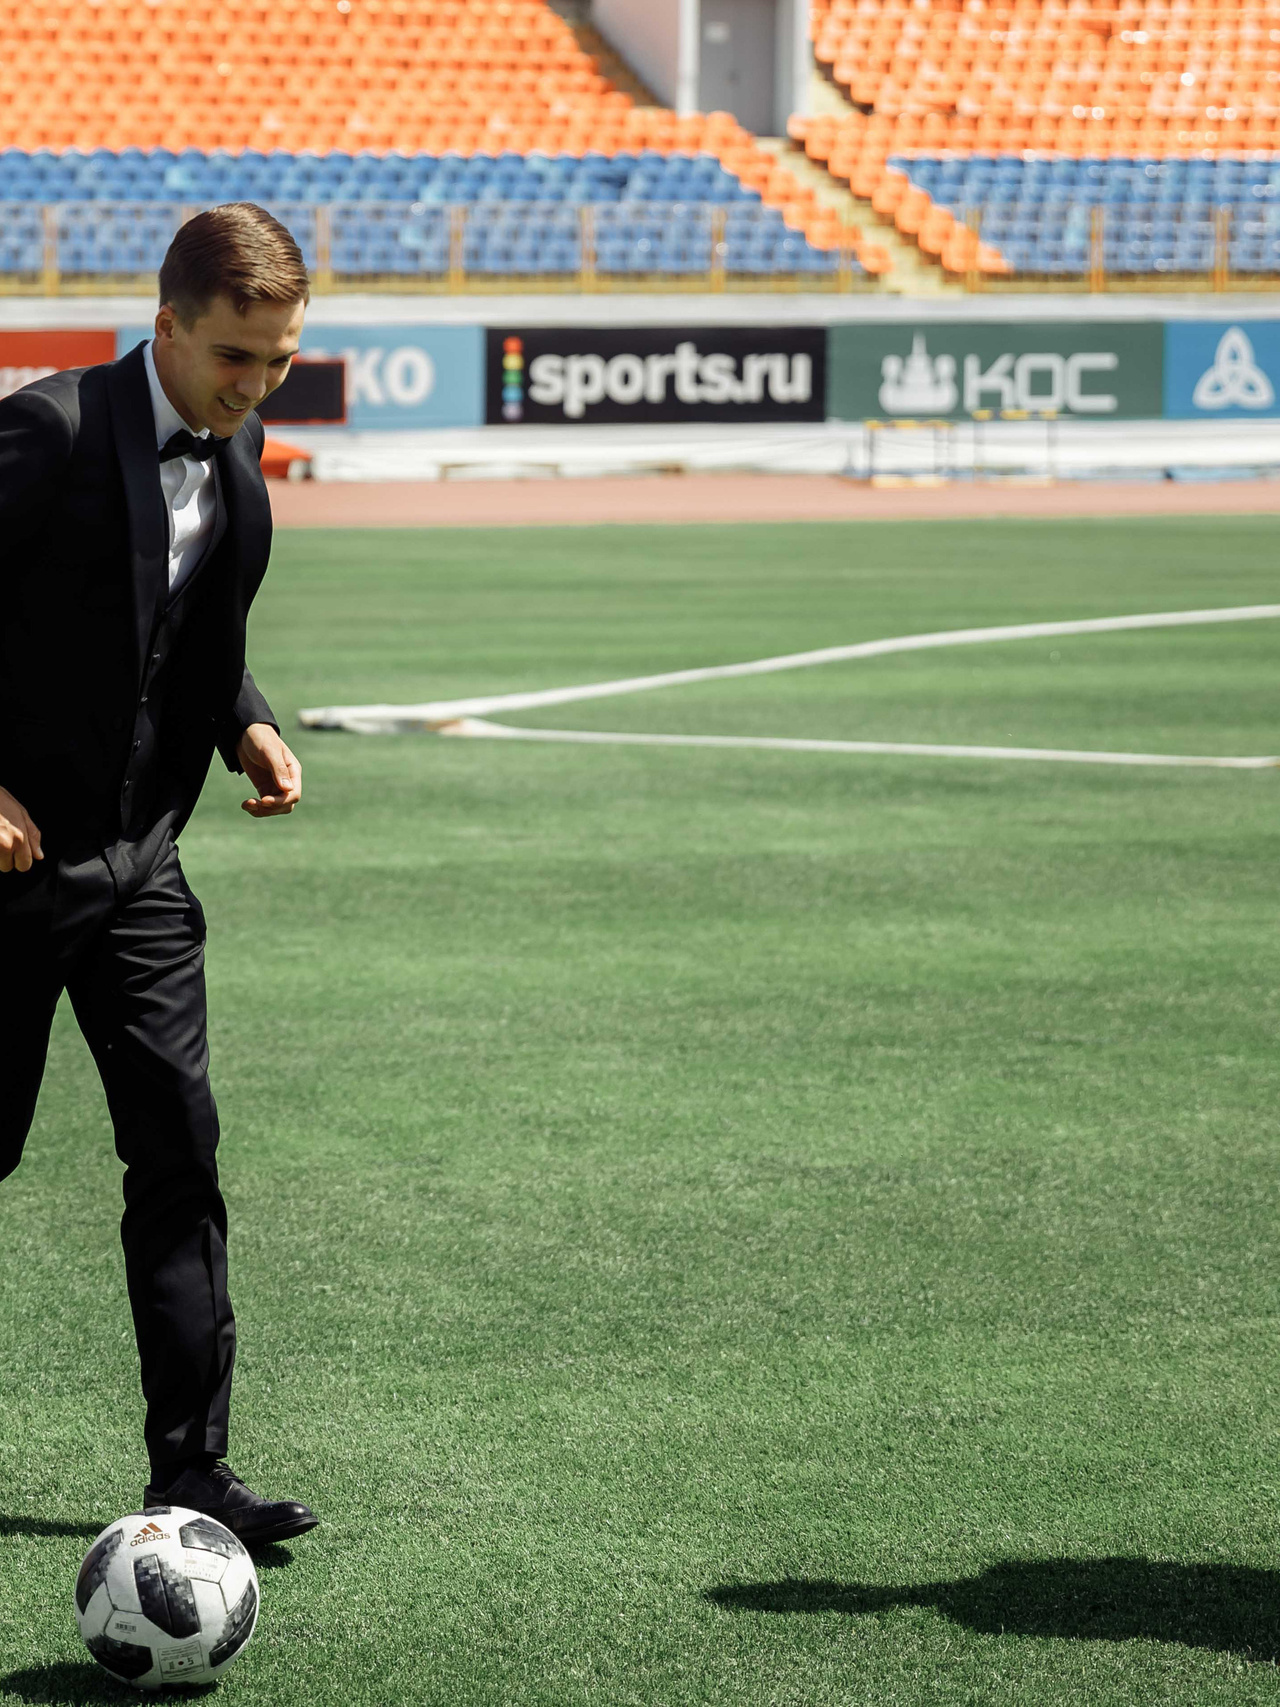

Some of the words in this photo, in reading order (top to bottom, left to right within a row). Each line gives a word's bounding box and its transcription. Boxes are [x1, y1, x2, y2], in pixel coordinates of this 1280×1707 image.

[304, 346, 436, 406] КО
[529, 342, 813, 418] sports.ru
[130, 1532, 171, 1547] adidas
